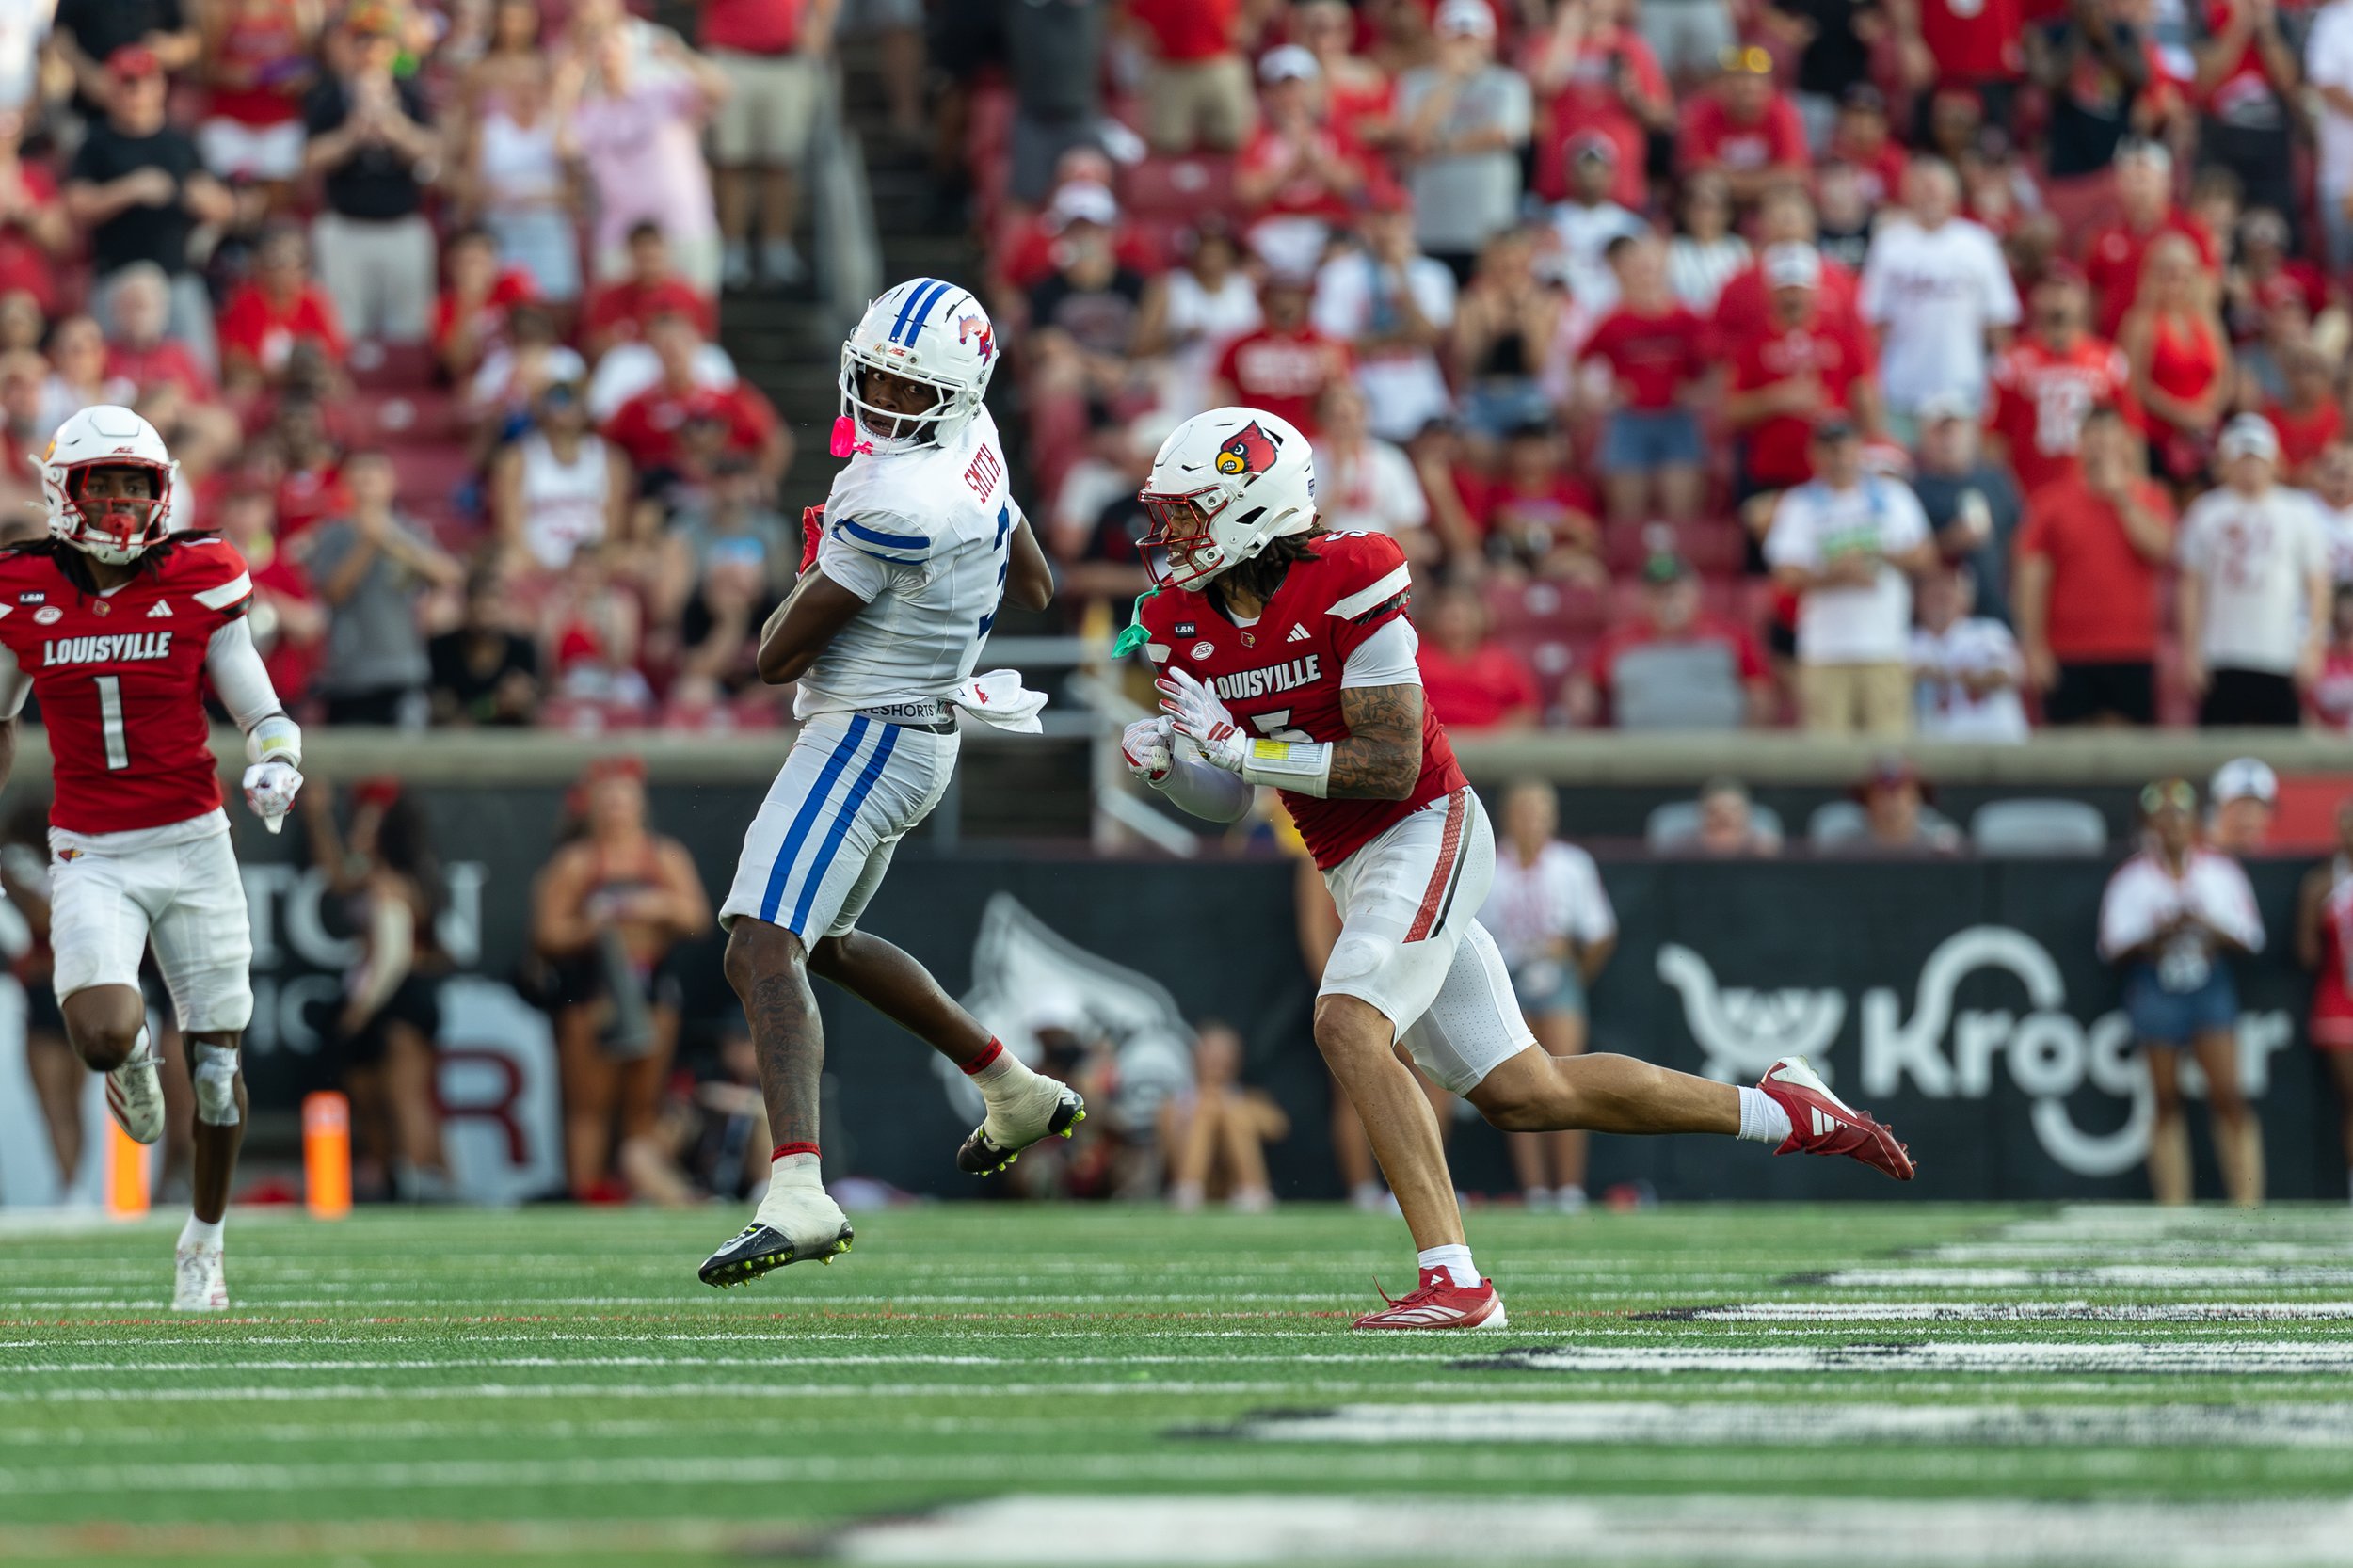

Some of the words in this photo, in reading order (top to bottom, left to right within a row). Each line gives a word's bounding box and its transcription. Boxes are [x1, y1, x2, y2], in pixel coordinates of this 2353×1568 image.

[964, 442, 1001, 504] SMITH
[977, 500, 1011, 641] 3
[42, 631, 173, 667] LOUISVILLE
[1175, 625, 1195, 633] L&N
[1194, 644, 1210, 656] ACC
[1215, 653, 1321, 700] OUISVILLE
[93, 674, 129, 771] 1
[1859, 924, 2294, 1176] Krogr
